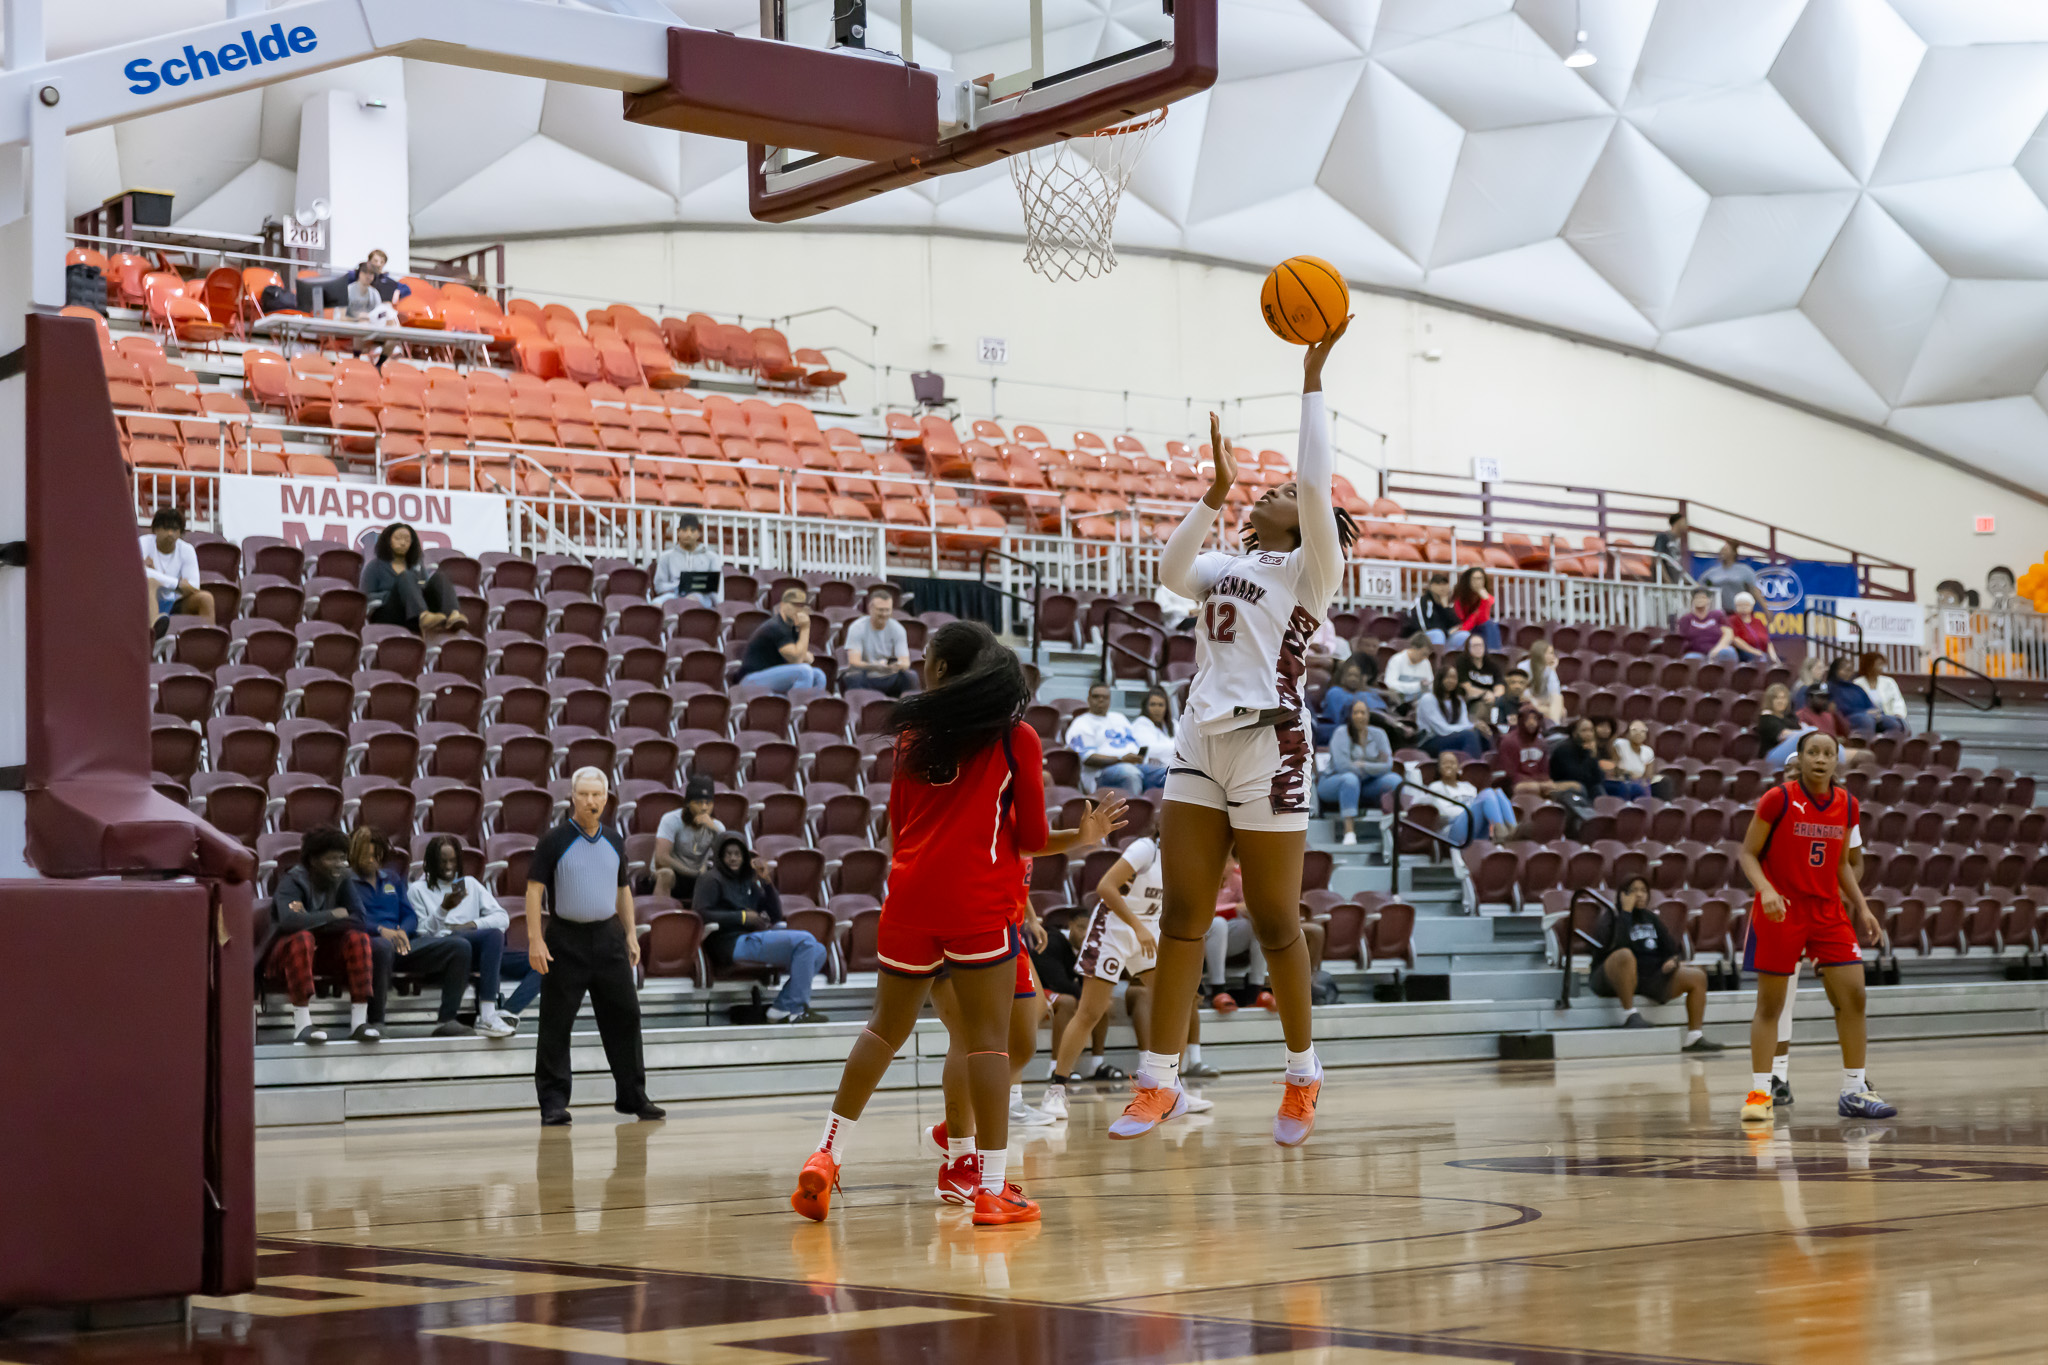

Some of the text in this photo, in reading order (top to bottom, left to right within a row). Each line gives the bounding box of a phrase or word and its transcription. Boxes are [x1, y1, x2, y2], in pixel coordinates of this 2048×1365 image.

[124, 23, 318, 95] Schelde
[290, 229, 319, 245] 208
[983, 346, 1006, 361] 207
[280, 484, 452, 525] MAROON
[1368, 578, 1392, 595] 109
[1205, 601, 1237, 644] 12
[1808, 840, 1828, 868] 5
